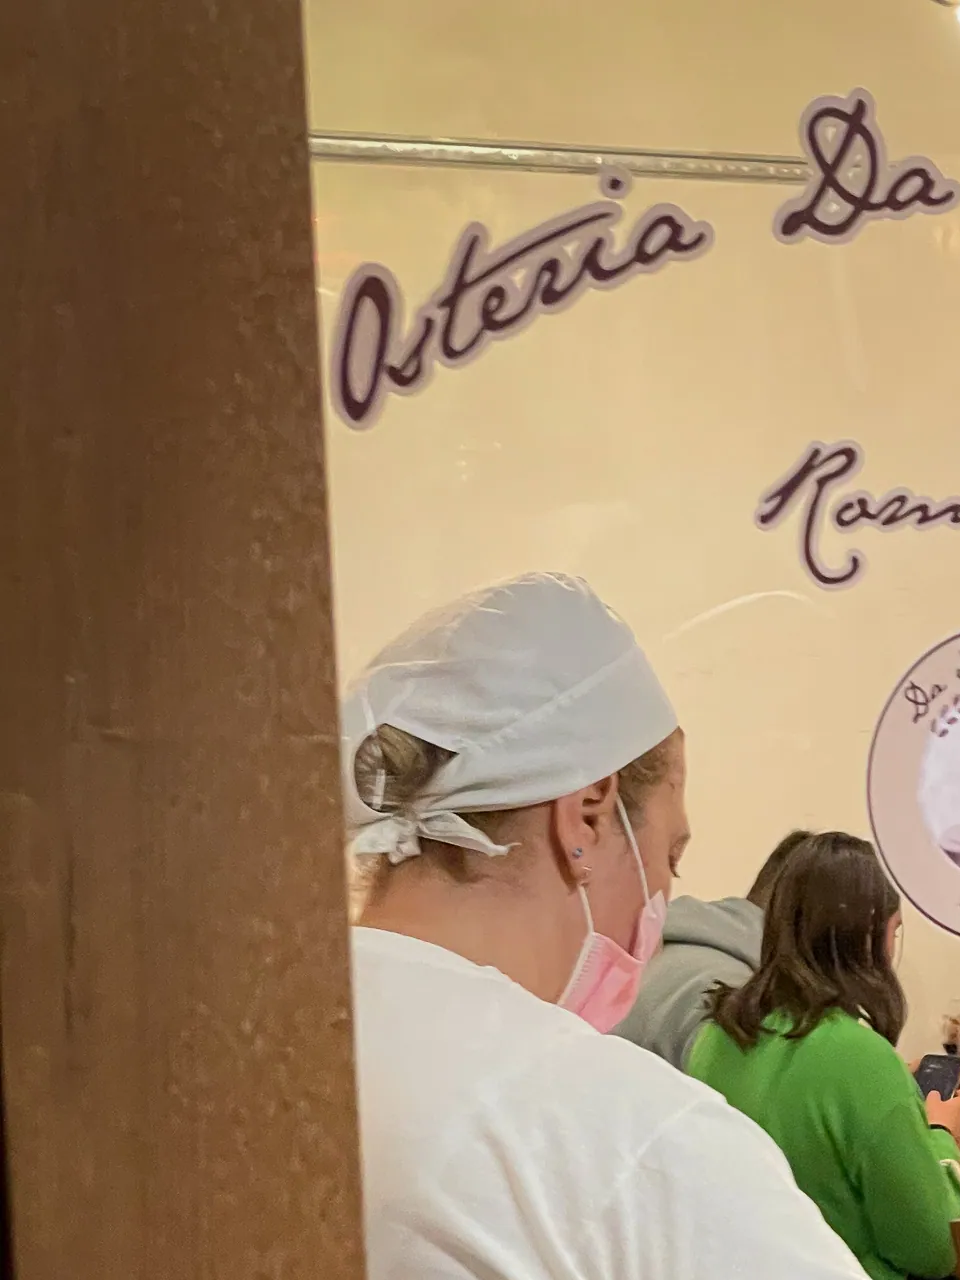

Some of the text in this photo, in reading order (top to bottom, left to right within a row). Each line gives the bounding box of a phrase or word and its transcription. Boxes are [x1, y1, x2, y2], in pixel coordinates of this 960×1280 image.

[340, 176, 707, 422] Osteria
[781, 97, 954, 236] Da
[904, 680, 947, 723] Da
